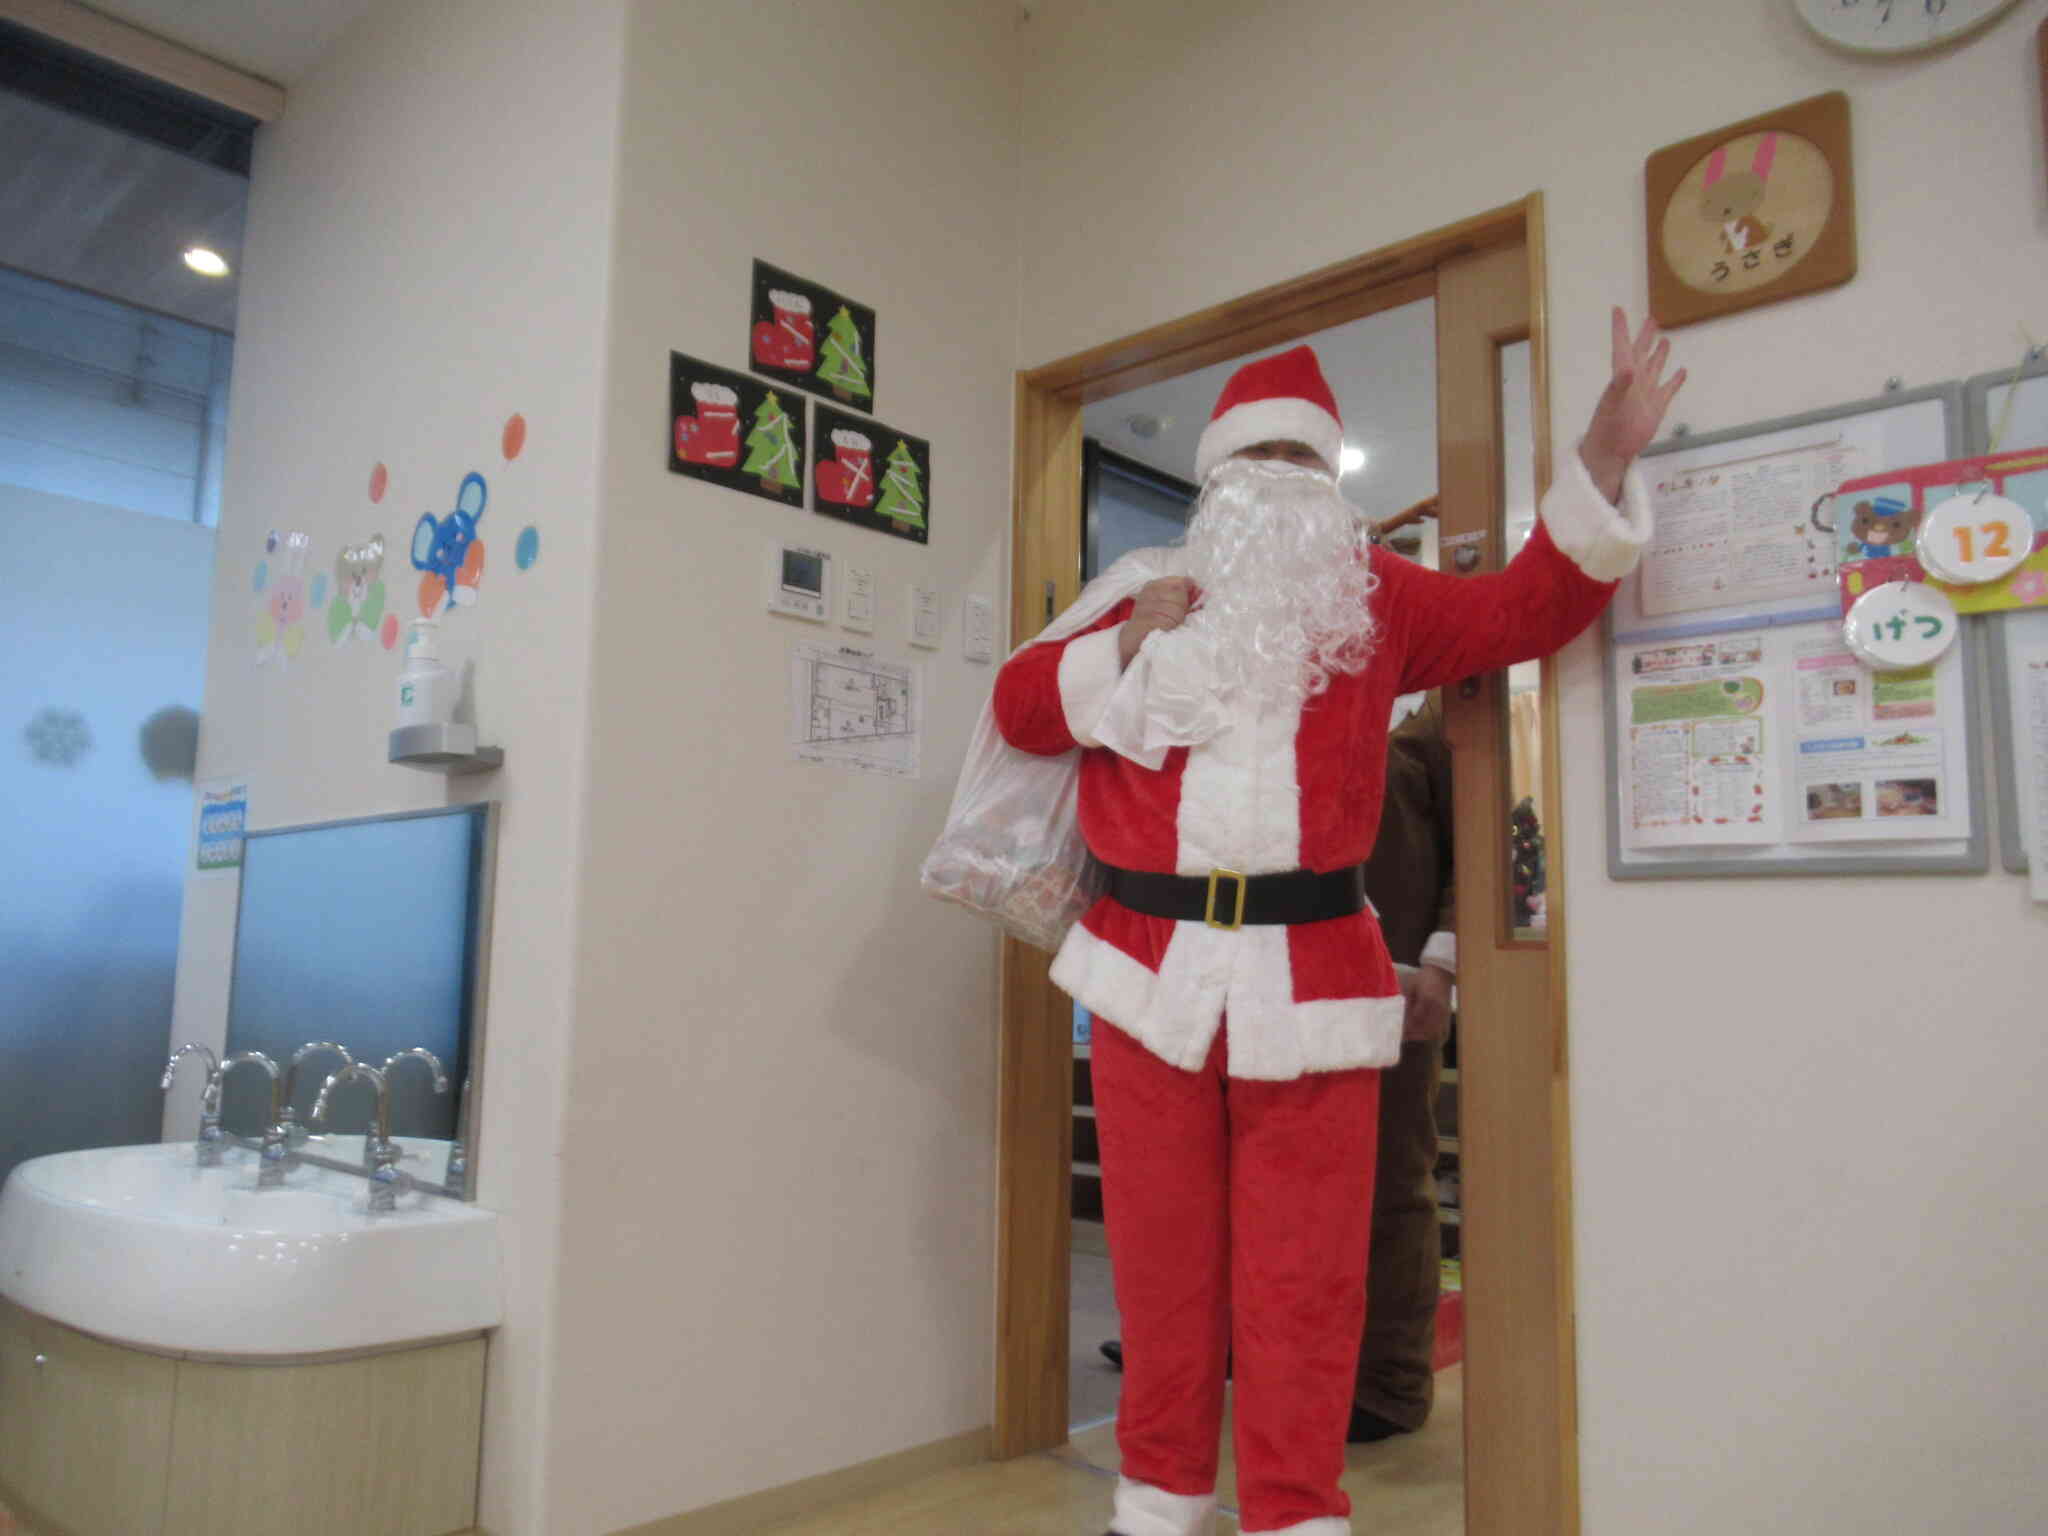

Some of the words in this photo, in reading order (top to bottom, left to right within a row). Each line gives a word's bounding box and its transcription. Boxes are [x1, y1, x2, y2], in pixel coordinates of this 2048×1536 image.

[1711, 232, 1793, 281] うさぎ
[1952, 521, 2010, 563] 12
